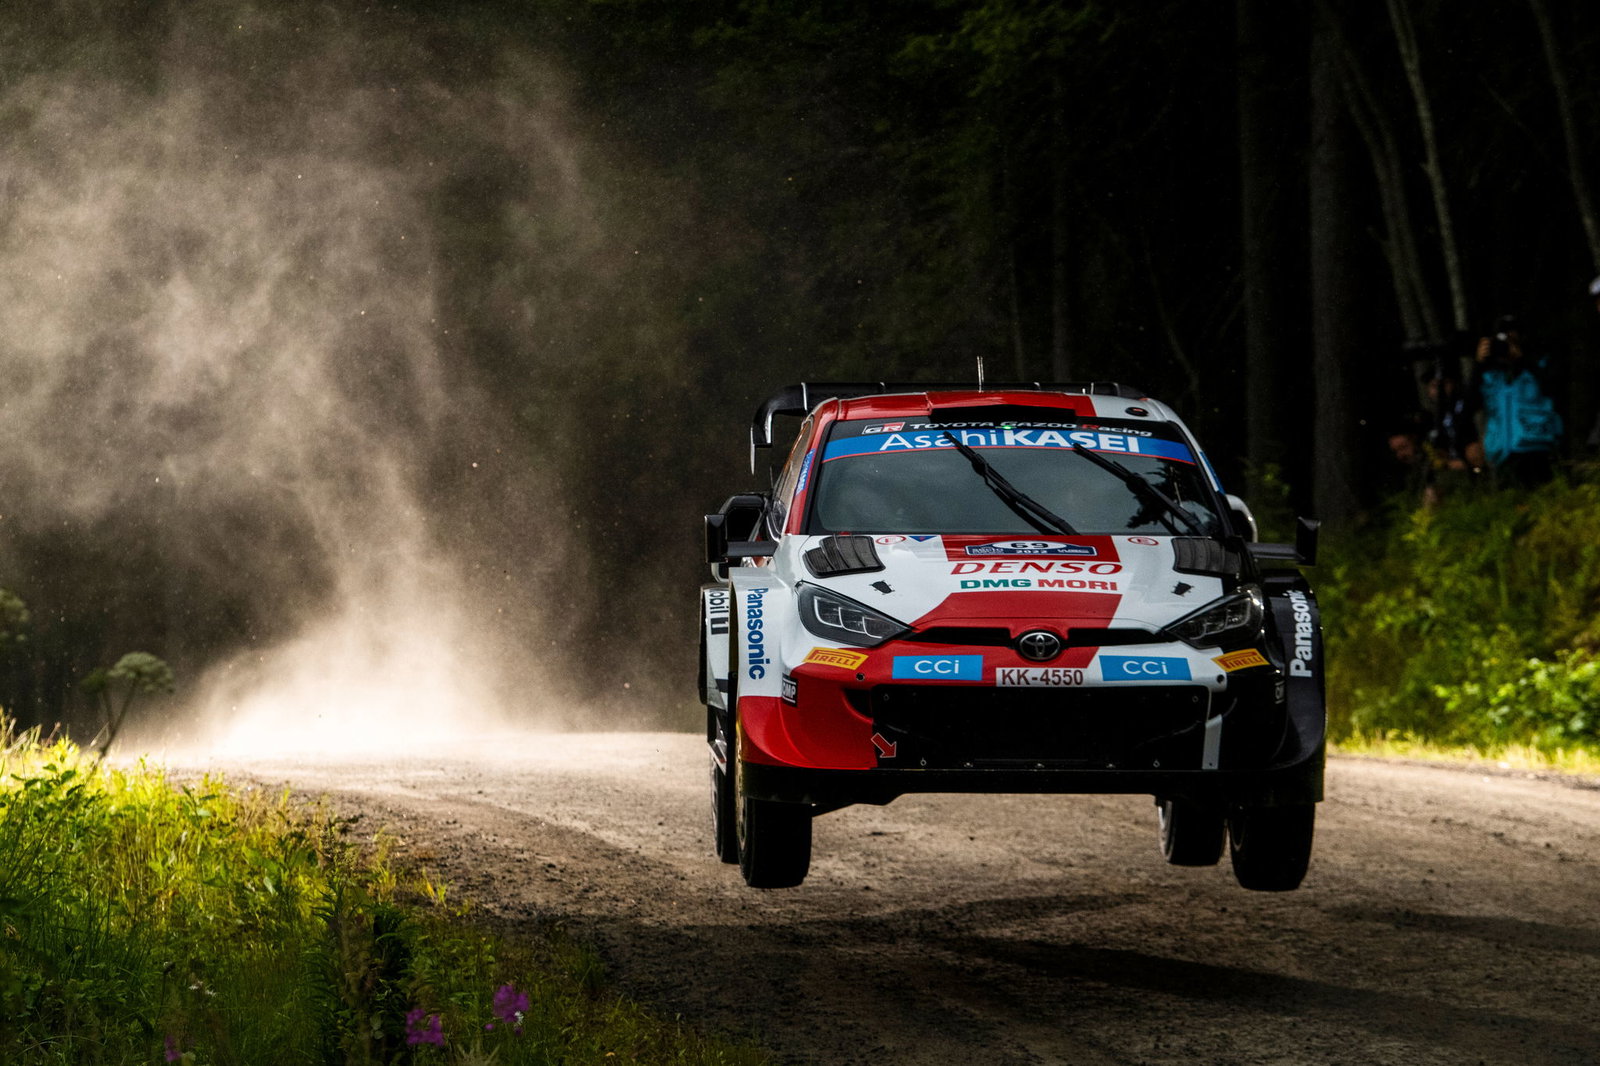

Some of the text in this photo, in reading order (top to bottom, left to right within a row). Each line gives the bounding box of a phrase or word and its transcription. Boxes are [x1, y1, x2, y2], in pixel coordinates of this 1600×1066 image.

[864, 424, 902, 435] GR
[909, 421, 1153, 437] TOYOTA GAZOO Racing
[951, 562, 1123, 575] DENSO
[960, 578, 1118, 591] DMG MORI
[709, 589, 729, 614] obil
[747, 588, 770, 680] Panasonic
[807, 649, 861, 667] PIRELLI
[1217, 651, 1264, 669] PIRELLI
[1001, 669, 1084, 686] KK-4550
